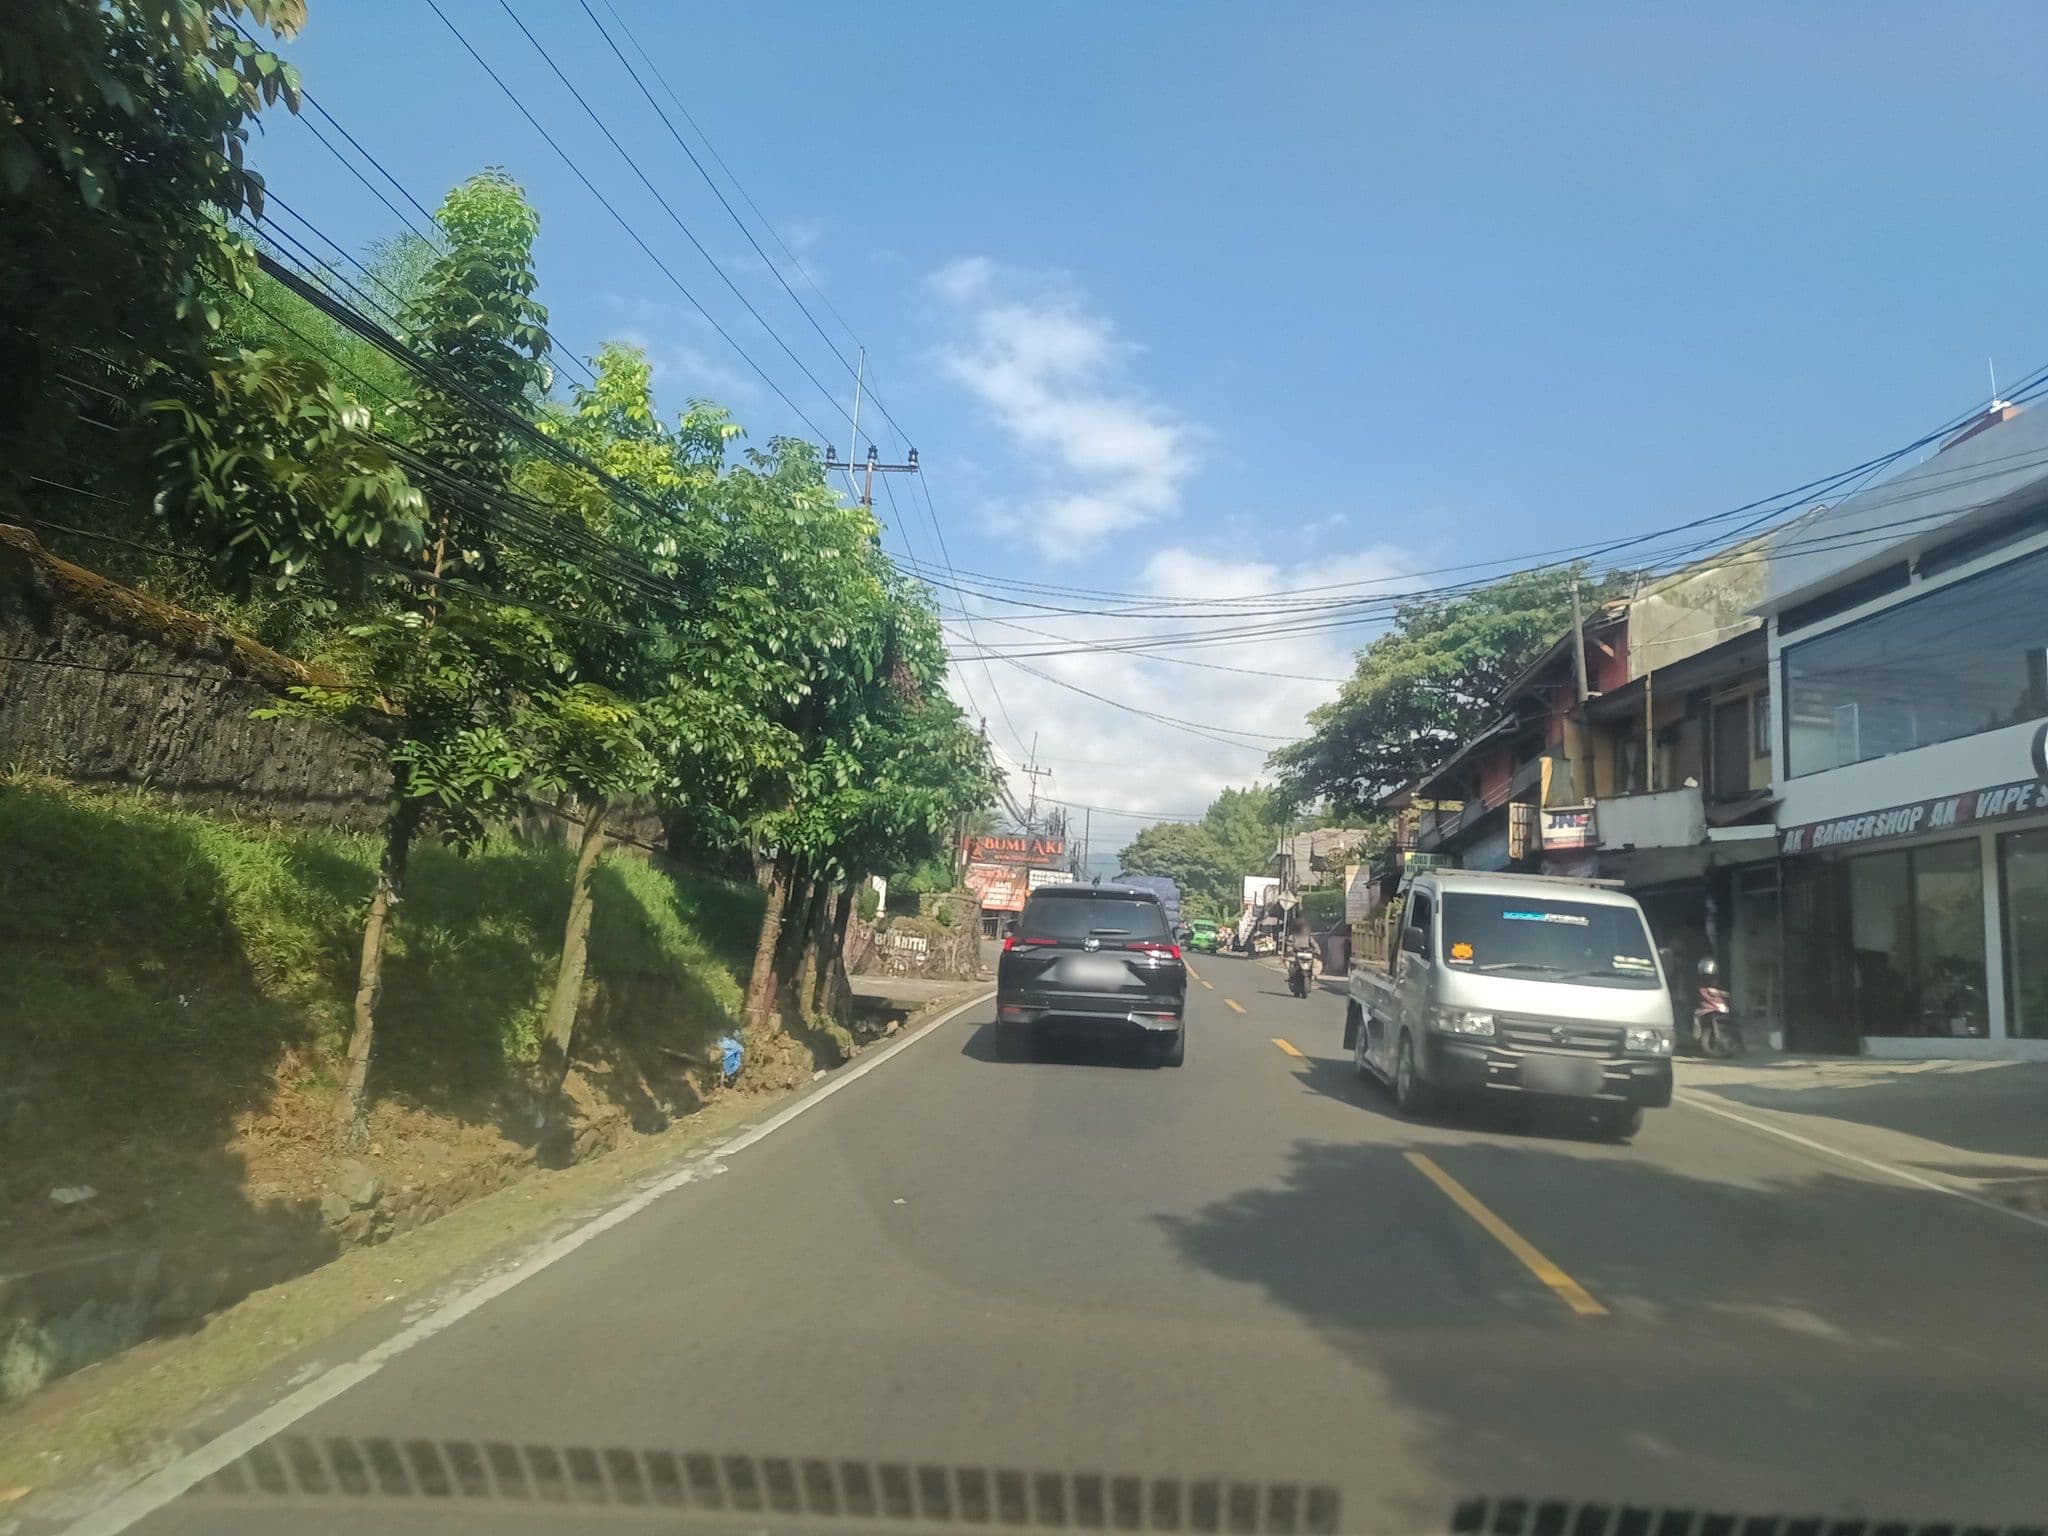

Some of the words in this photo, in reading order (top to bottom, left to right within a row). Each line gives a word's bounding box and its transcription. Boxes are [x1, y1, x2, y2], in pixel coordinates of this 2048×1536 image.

[1812, 806, 1925, 848] BARBERSHOP
[1975, 783, 2035, 818] VAPE
[984, 836, 1026, 851] BUMI
[1032, 839, 1065, 855] AKI
